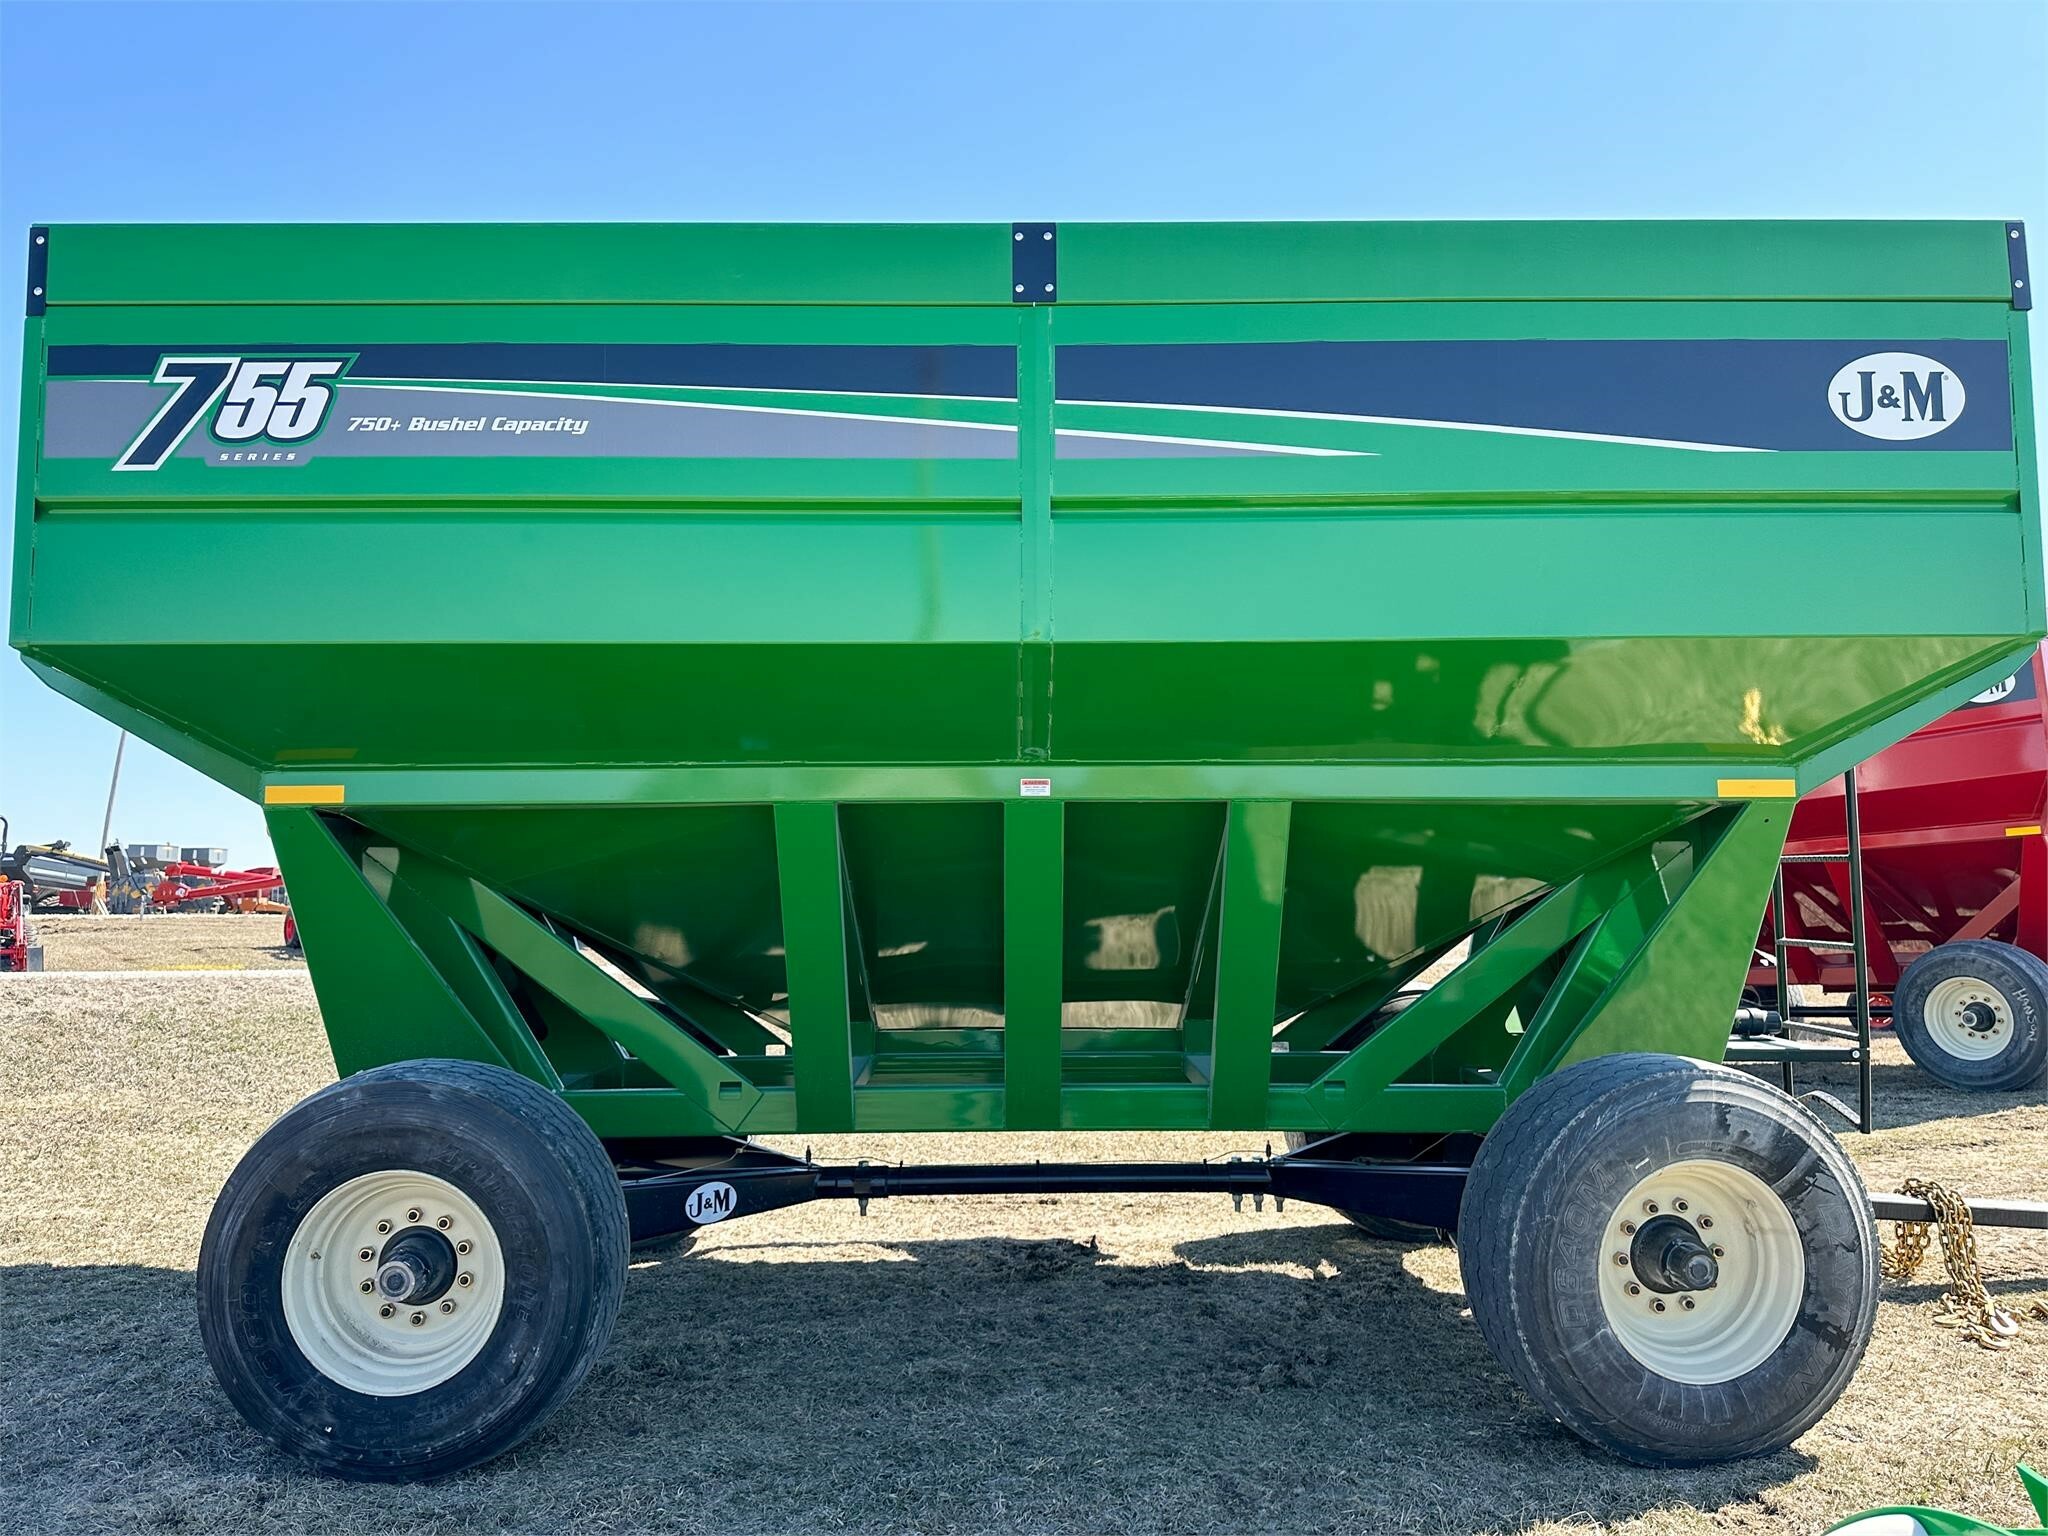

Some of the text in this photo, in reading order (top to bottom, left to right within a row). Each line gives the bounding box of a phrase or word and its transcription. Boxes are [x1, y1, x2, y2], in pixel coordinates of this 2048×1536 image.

[1838, 371, 1947, 422] J&M
[111, 356, 343, 471] 755
[347, 416, 589, 435] 750+ Bushel Capacity
[219, 452, 296, 461] SERIES
[688, 1187, 731, 1218] J&M
